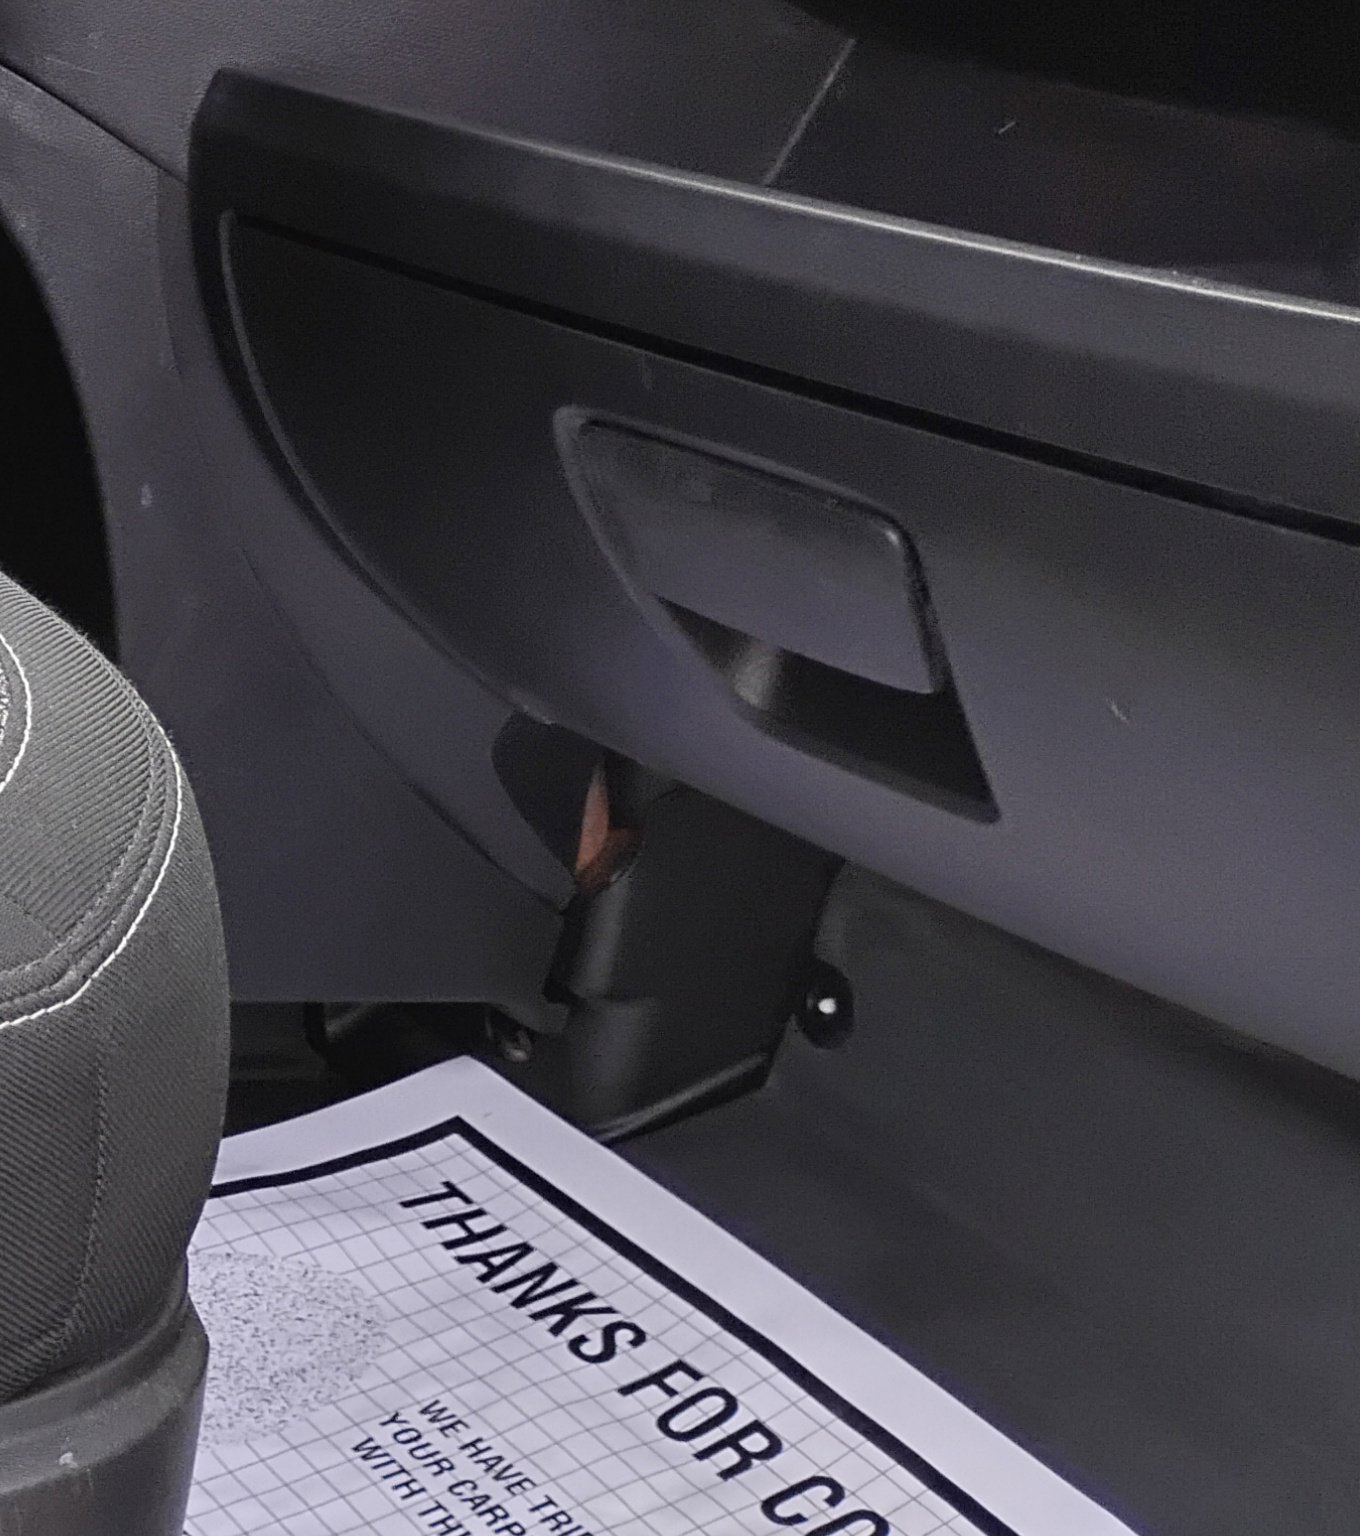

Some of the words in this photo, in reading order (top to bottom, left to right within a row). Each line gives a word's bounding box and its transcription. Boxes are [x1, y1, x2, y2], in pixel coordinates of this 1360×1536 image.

[399, 1181, 646, 1364] THANKS
[617, 1360, 783, 1482] FOR
[352, 1436, 427, 1500] WITH
[380, 1411, 457, 1477] YOUR
[448, 1479, 527, 1536] CARP
[418, 1399, 470, 1439] WE
[459, 1437, 538, 1497] HAVE
[529, 1494, 596, 1536] TRI
